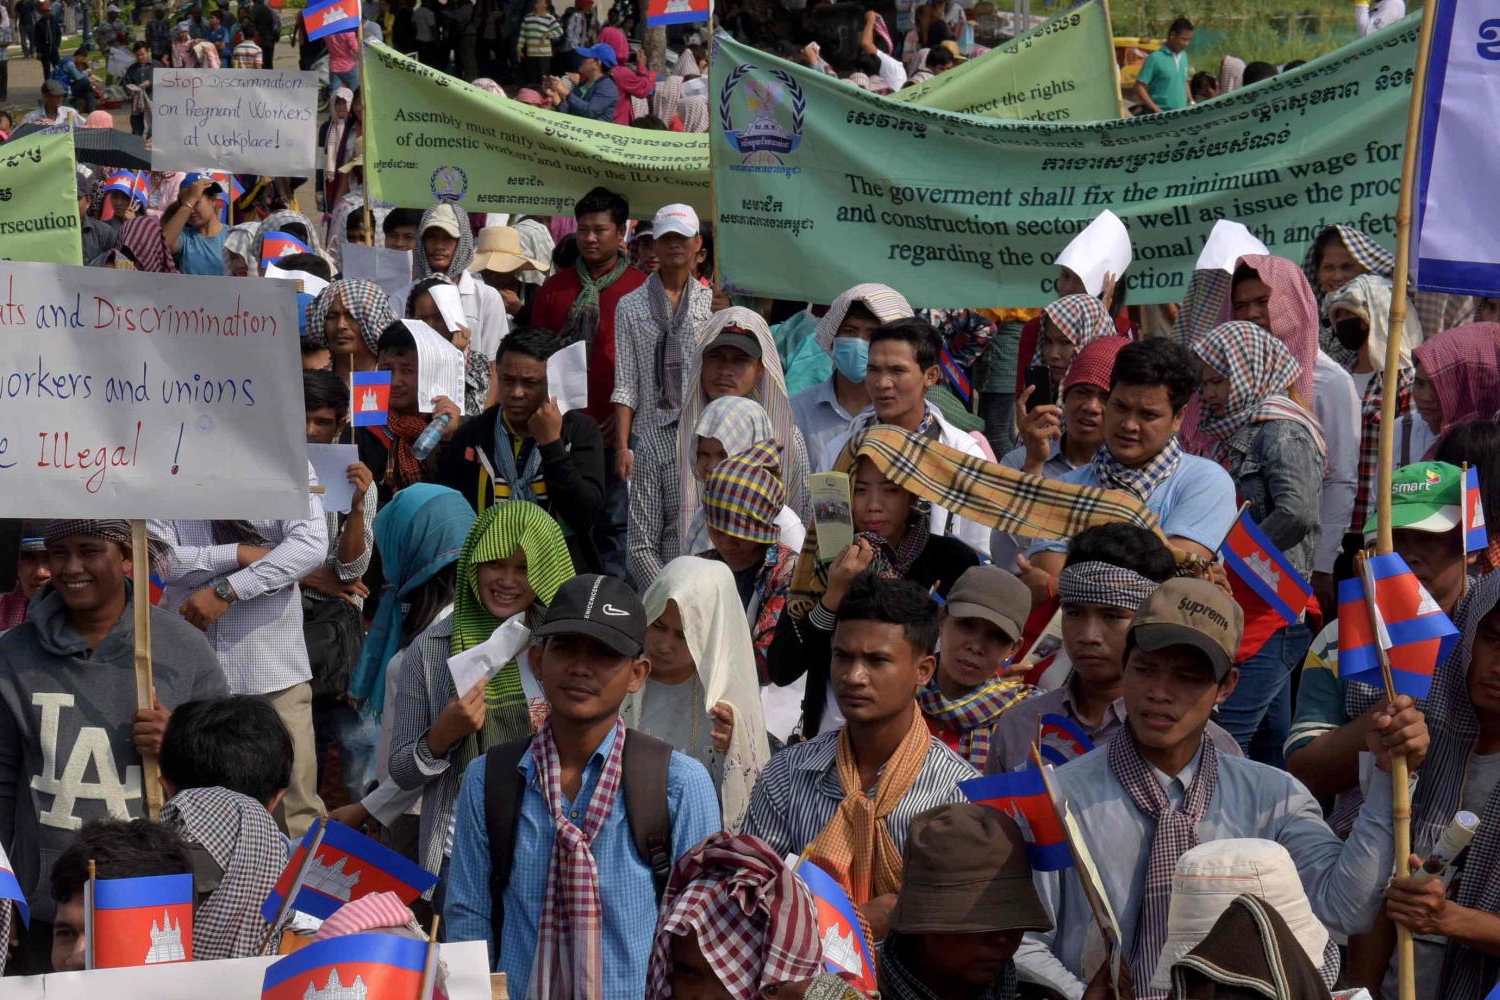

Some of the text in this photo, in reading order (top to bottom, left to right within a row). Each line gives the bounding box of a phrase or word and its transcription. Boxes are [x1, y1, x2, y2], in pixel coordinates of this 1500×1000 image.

[162, 71, 302, 97] Stop Discrimination
[1002, 92, 1026, 107] the
[1030, 80, 1076, 100] rights
[158, 97, 312, 128] on Pregnant Workers
[394, 108, 462, 129] Assembly
[466, 121, 497, 138] must
[500, 131, 534, 150] ratify
[184, 125, 200, 147] at
[396, 132, 412, 146] of
[415, 133, 480, 149] domestic
[538, 158, 562, 170] and
[565, 163, 600, 179] ratify
[605, 169, 626, 181] the
[629, 171, 660, 184] ILO
[845, 140, 1403, 207] The goverment shall fix the minimum wage for
[836, 204, 876, 223] and
[880, 210, 1010, 236] construction
[1137, 204, 1192, 230] well
[1199, 205, 1227, 222] as
[1232, 190, 1298, 217] issue
[1304, 182, 1343, 205] the
[888, 242, 994, 269] regarding
[997, 246, 1034, 266] the
[36, 293, 86, 329] and
[93, 294, 278, 337] Discrimination
[105, 362, 151, 404] and
[162, 373, 256, 406] unions
[37, 421, 142, 494] Illegal
[30, 692, 142, 831] LA
